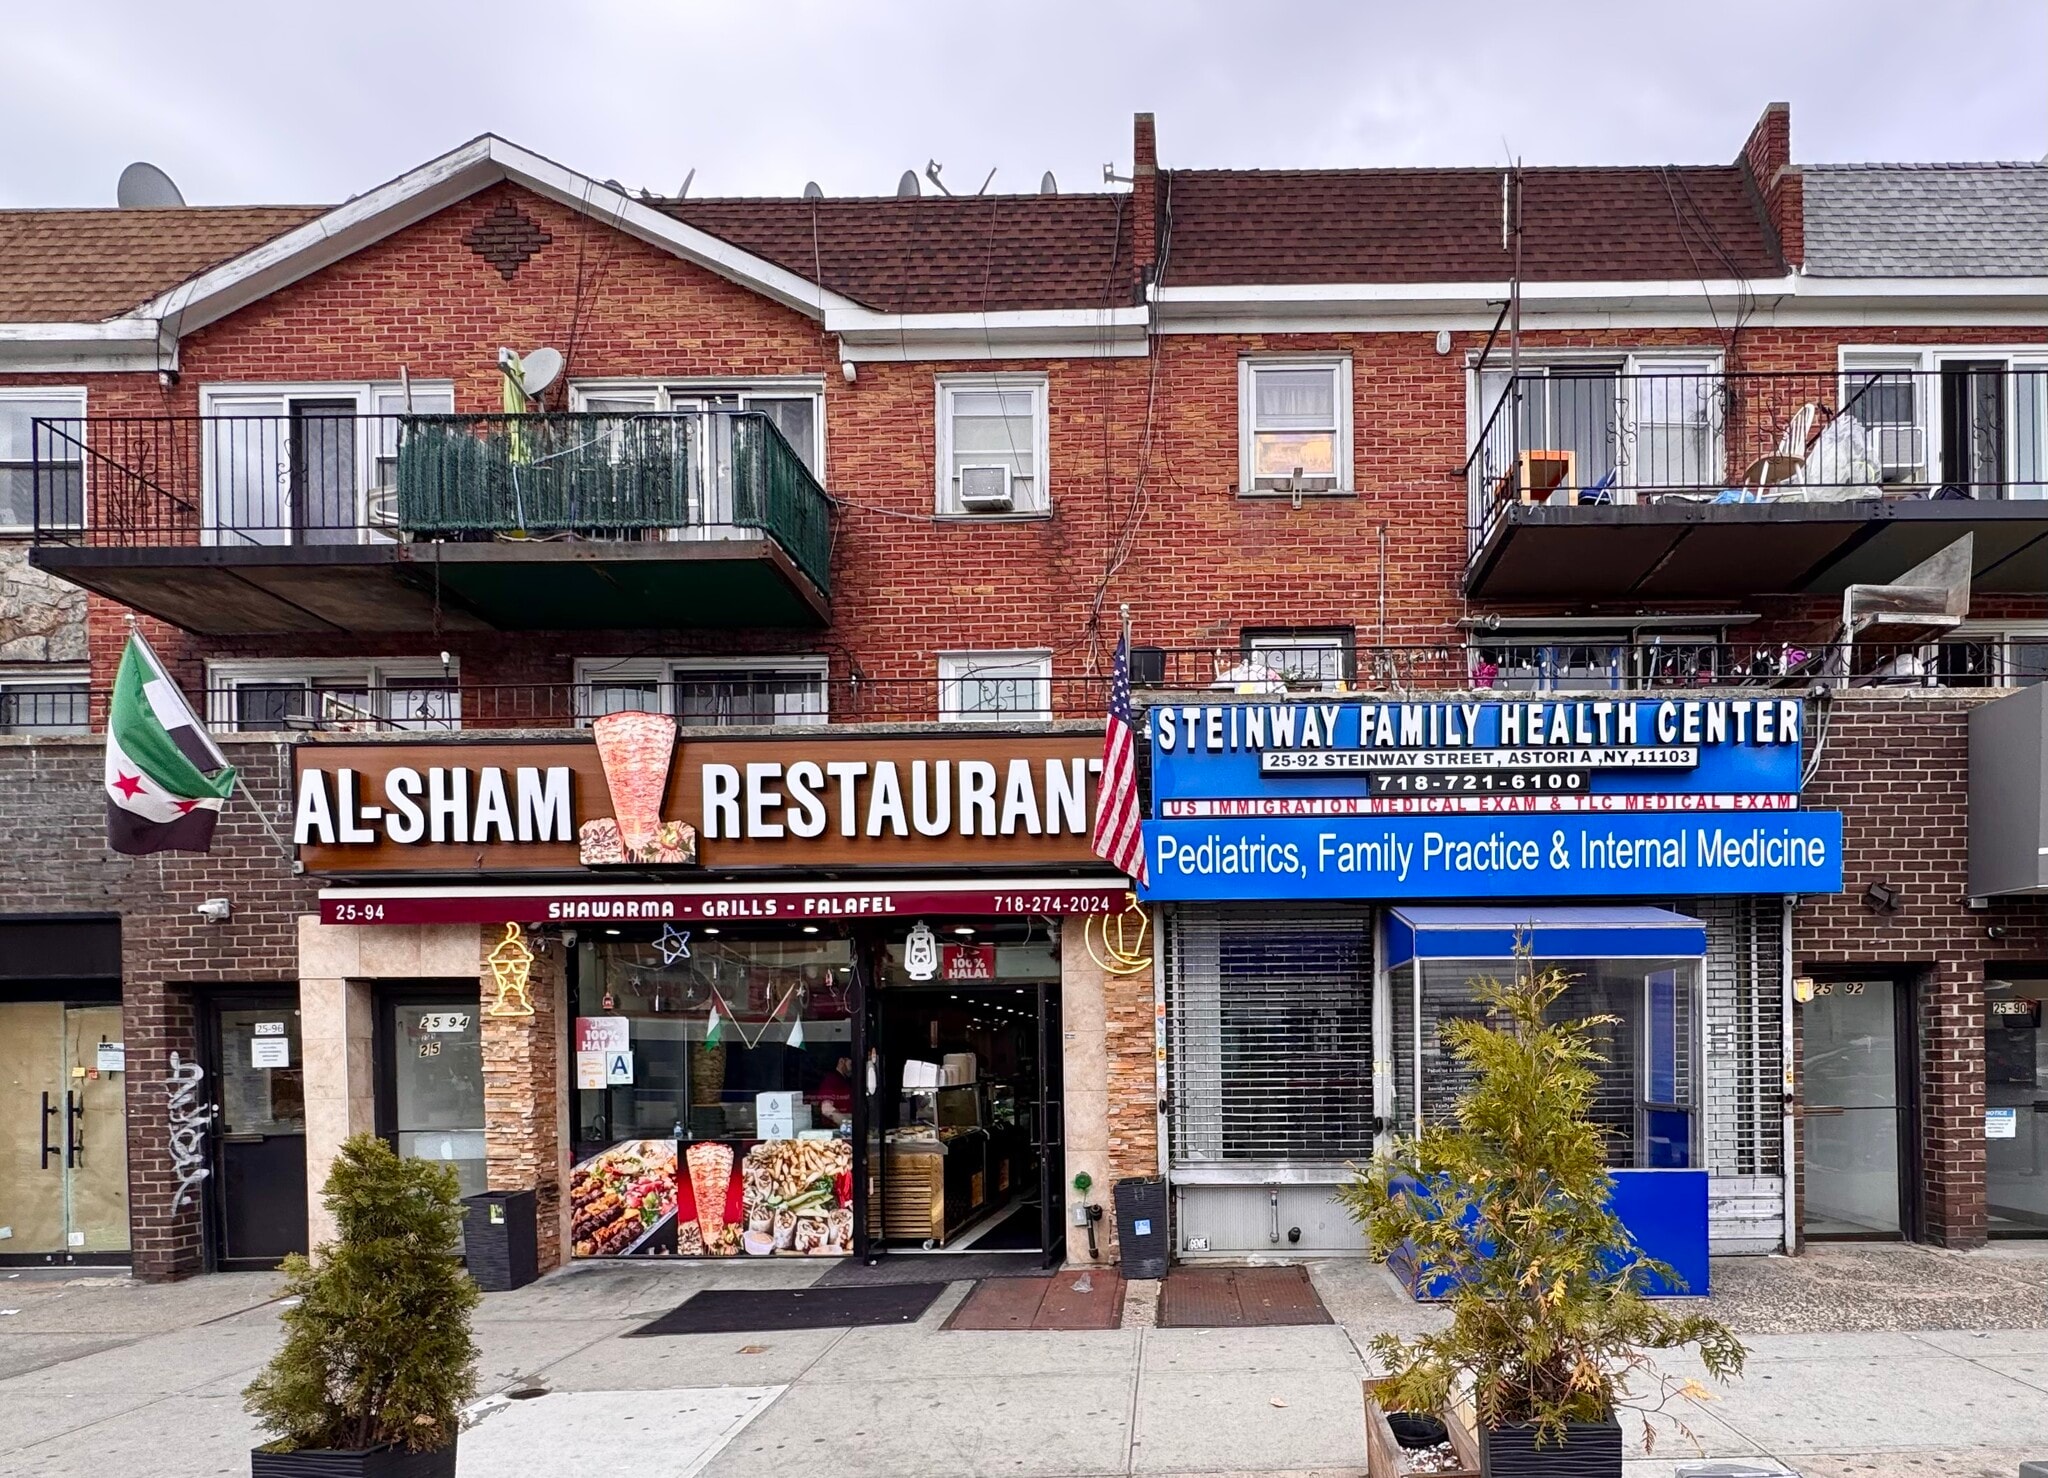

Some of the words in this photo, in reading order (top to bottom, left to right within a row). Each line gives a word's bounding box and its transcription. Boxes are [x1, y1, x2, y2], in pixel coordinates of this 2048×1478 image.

[1158, 704, 1340, 750] STEINWAY
[1360, 703, 1481, 748] FAMILY
[1501, 702, 1637, 746] HEALTH
[1658, 700, 1799, 744] CENTER
[1270, 754, 1318, 767] 25-92
[1324, 753, 1418, 766] STEINWAY
[1378, 774, 1580, 790] 718-721-6100
[294, 766, 572, 845] AL-SHAM
[702, 758, 1103, 838] RESTAURAN
[1171, 801, 1196, 815] US
[1210, 799, 1358, 815] IMMIGRATION
[1371, 797, 1466, 813] MEDICAL
[1480, 796, 1536, 812] EXAM
[1550, 796, 1561, 811] &
[1575, 795, 1612, 811] TLC
[1626, 794, 1720, 810] MEDICAL
[1733, 794, 1791, 809] EXAM
[1157, 833, 1307, 879] Pediatrics,
[1319, 832, 1413, 882] Family
[1424, 831, 1539, 871] Practice
[1550, 830, 1571, 870] &
[1581, 829, 1686, 869] Internal
[1698, 828, 1825, 868] Medicine
[335, 904, 385, 921] 25-94
[549, 901, 675, 919] SHAWARMA
[702, 899, 777, 917] GRILLS
[804, 896, 896, 914] FALAFEL
[994, 896, 1110, 913] 718-274-2024
[952, 958, 986, 969] 100%
[949, 968, 990, 979] HALAL
[1814, 983, 1832, 995] 25
[1845, 982, 1863, 994] 92
[1994, 1002, 2026, 1014] 25-90
[257, 1024, 284, 1033] 25-96
[421, 1017, 441, 1028] 25
[448, 1017, 468, 1027] 94
[420, 1043, 440, 1057] 25
[611, 1055, 628, 1075] A
